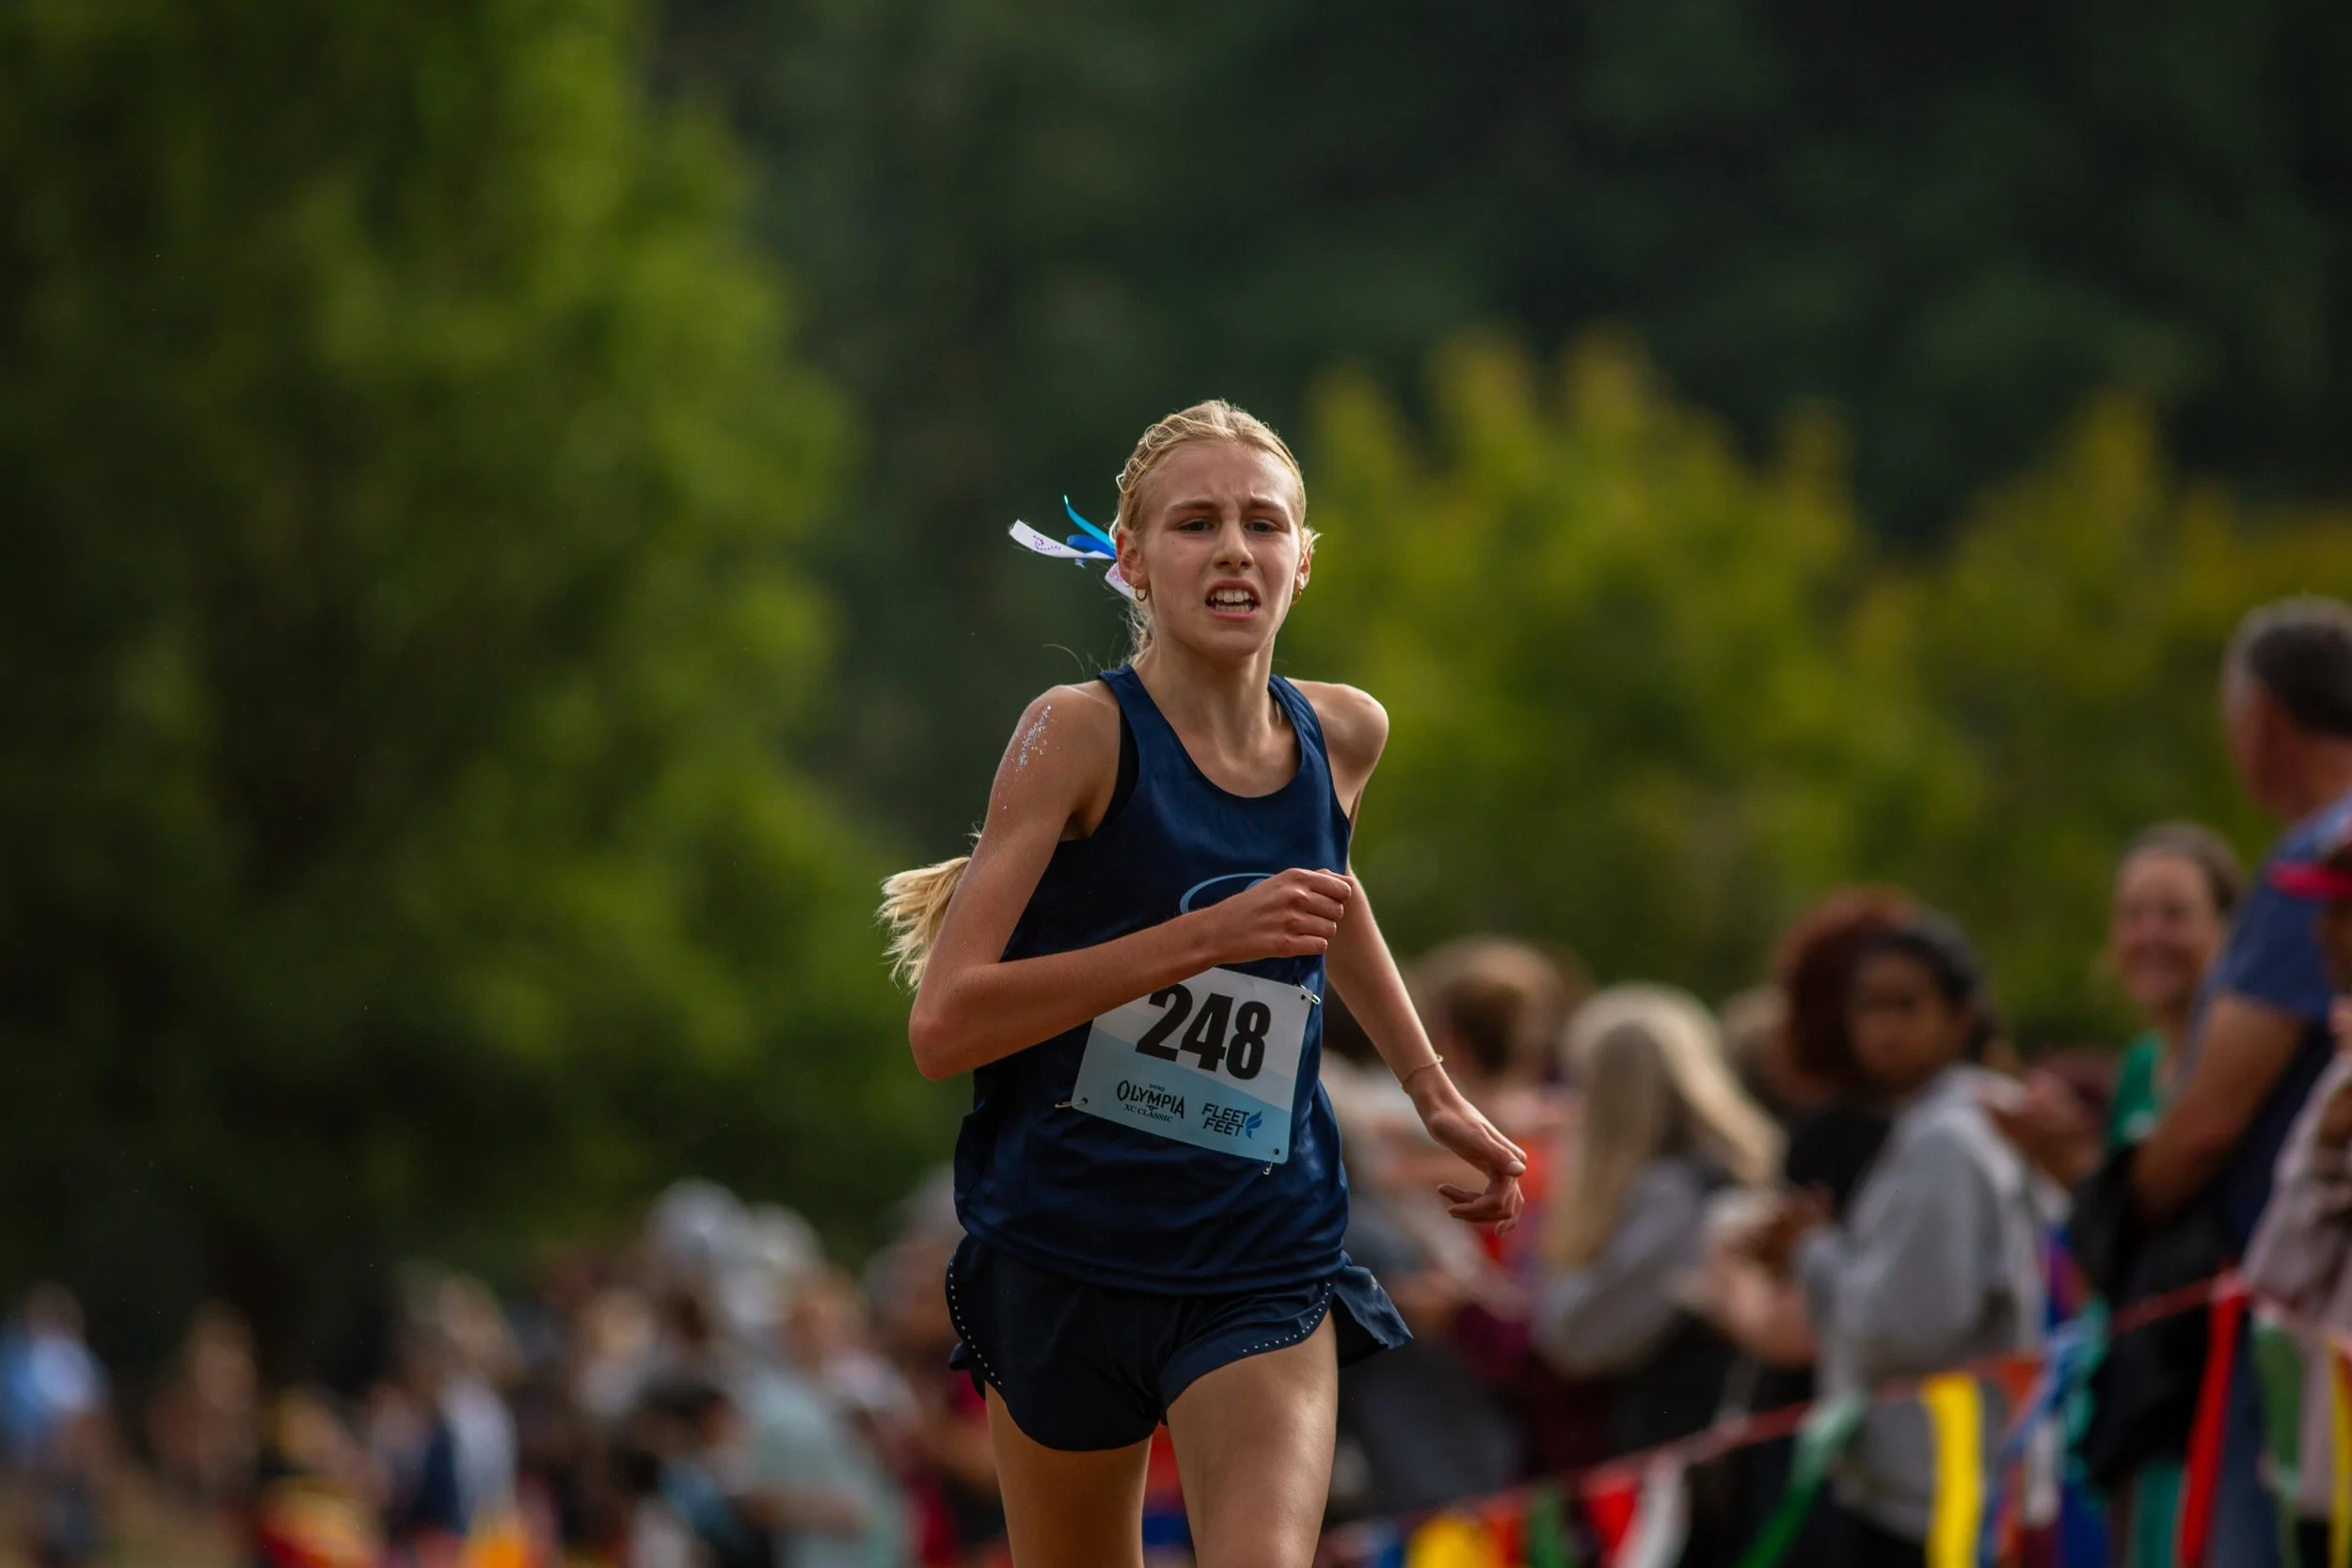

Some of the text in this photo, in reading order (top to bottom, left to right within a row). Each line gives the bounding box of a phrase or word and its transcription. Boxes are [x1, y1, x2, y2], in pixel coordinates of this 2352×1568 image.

[1136, 984, 1271, 1080] 248
[1117, 1080, 1185, 1119] OLYMPIA
[1124, 1103, 1173, 1123] XC CLASSIC
[1201, 1102, 1249, 1124] FLEET
[1202, 1117, 1243, 1136] FEET
